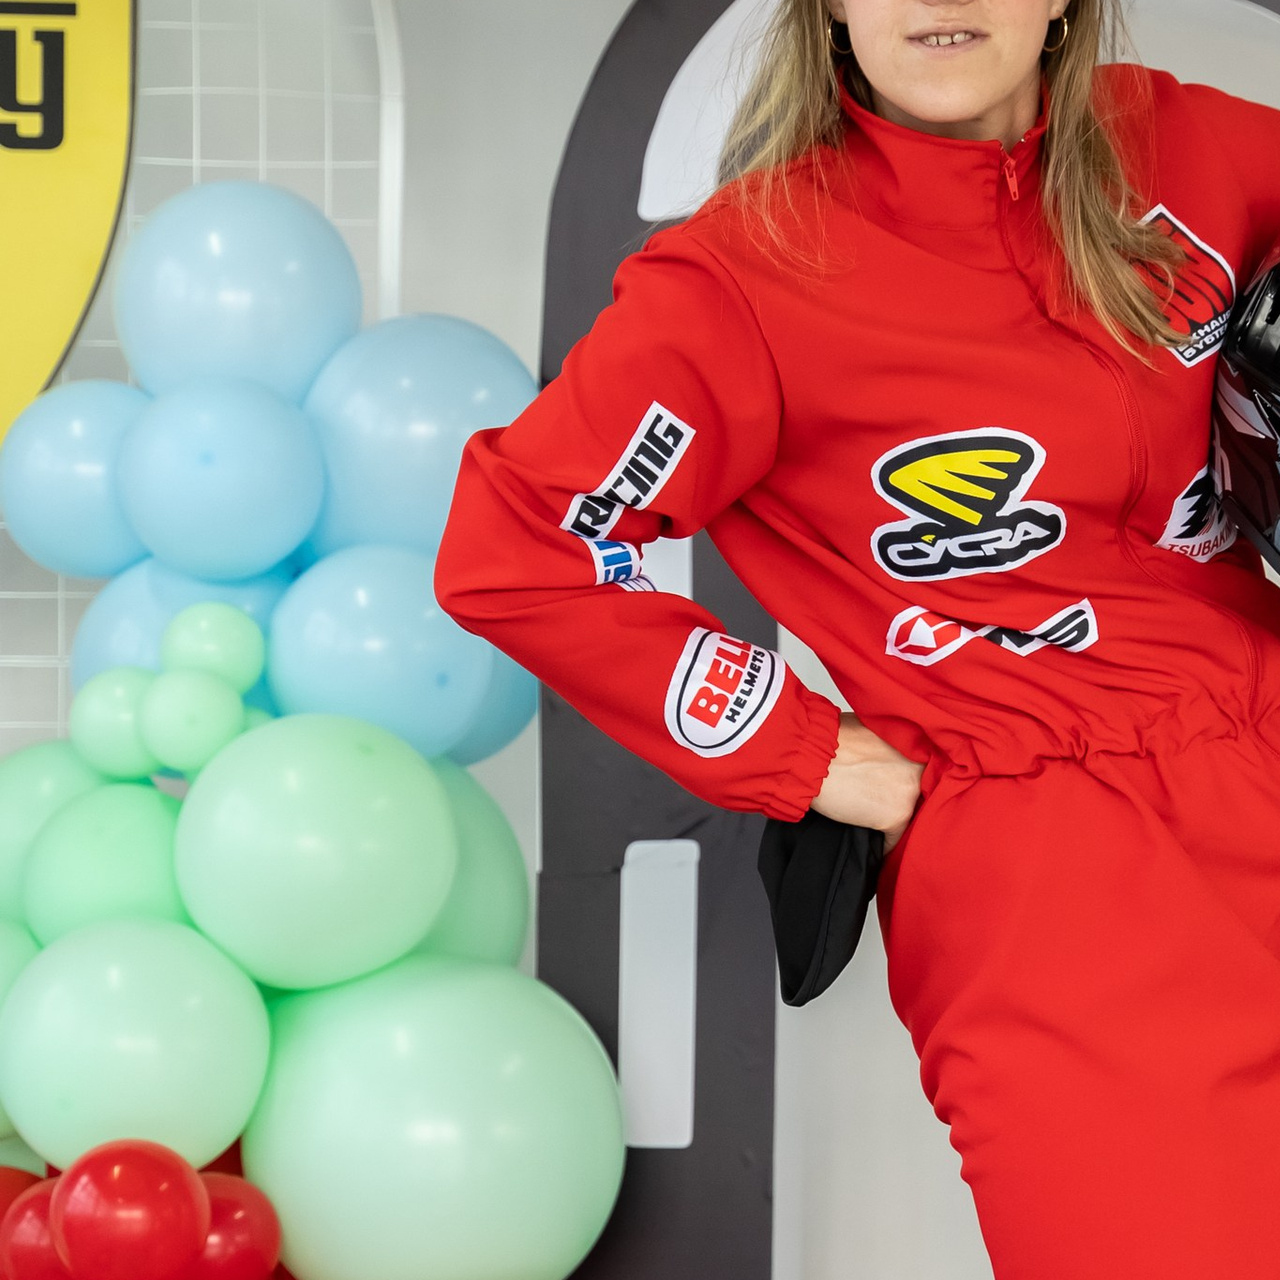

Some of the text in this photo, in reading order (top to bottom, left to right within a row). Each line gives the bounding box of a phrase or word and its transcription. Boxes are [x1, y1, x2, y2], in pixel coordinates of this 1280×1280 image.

[886, 520, 1052, 567] CYCRA
[686, 636, 752, 729] BELL
[725, 649, 766, 723] HELMETS
